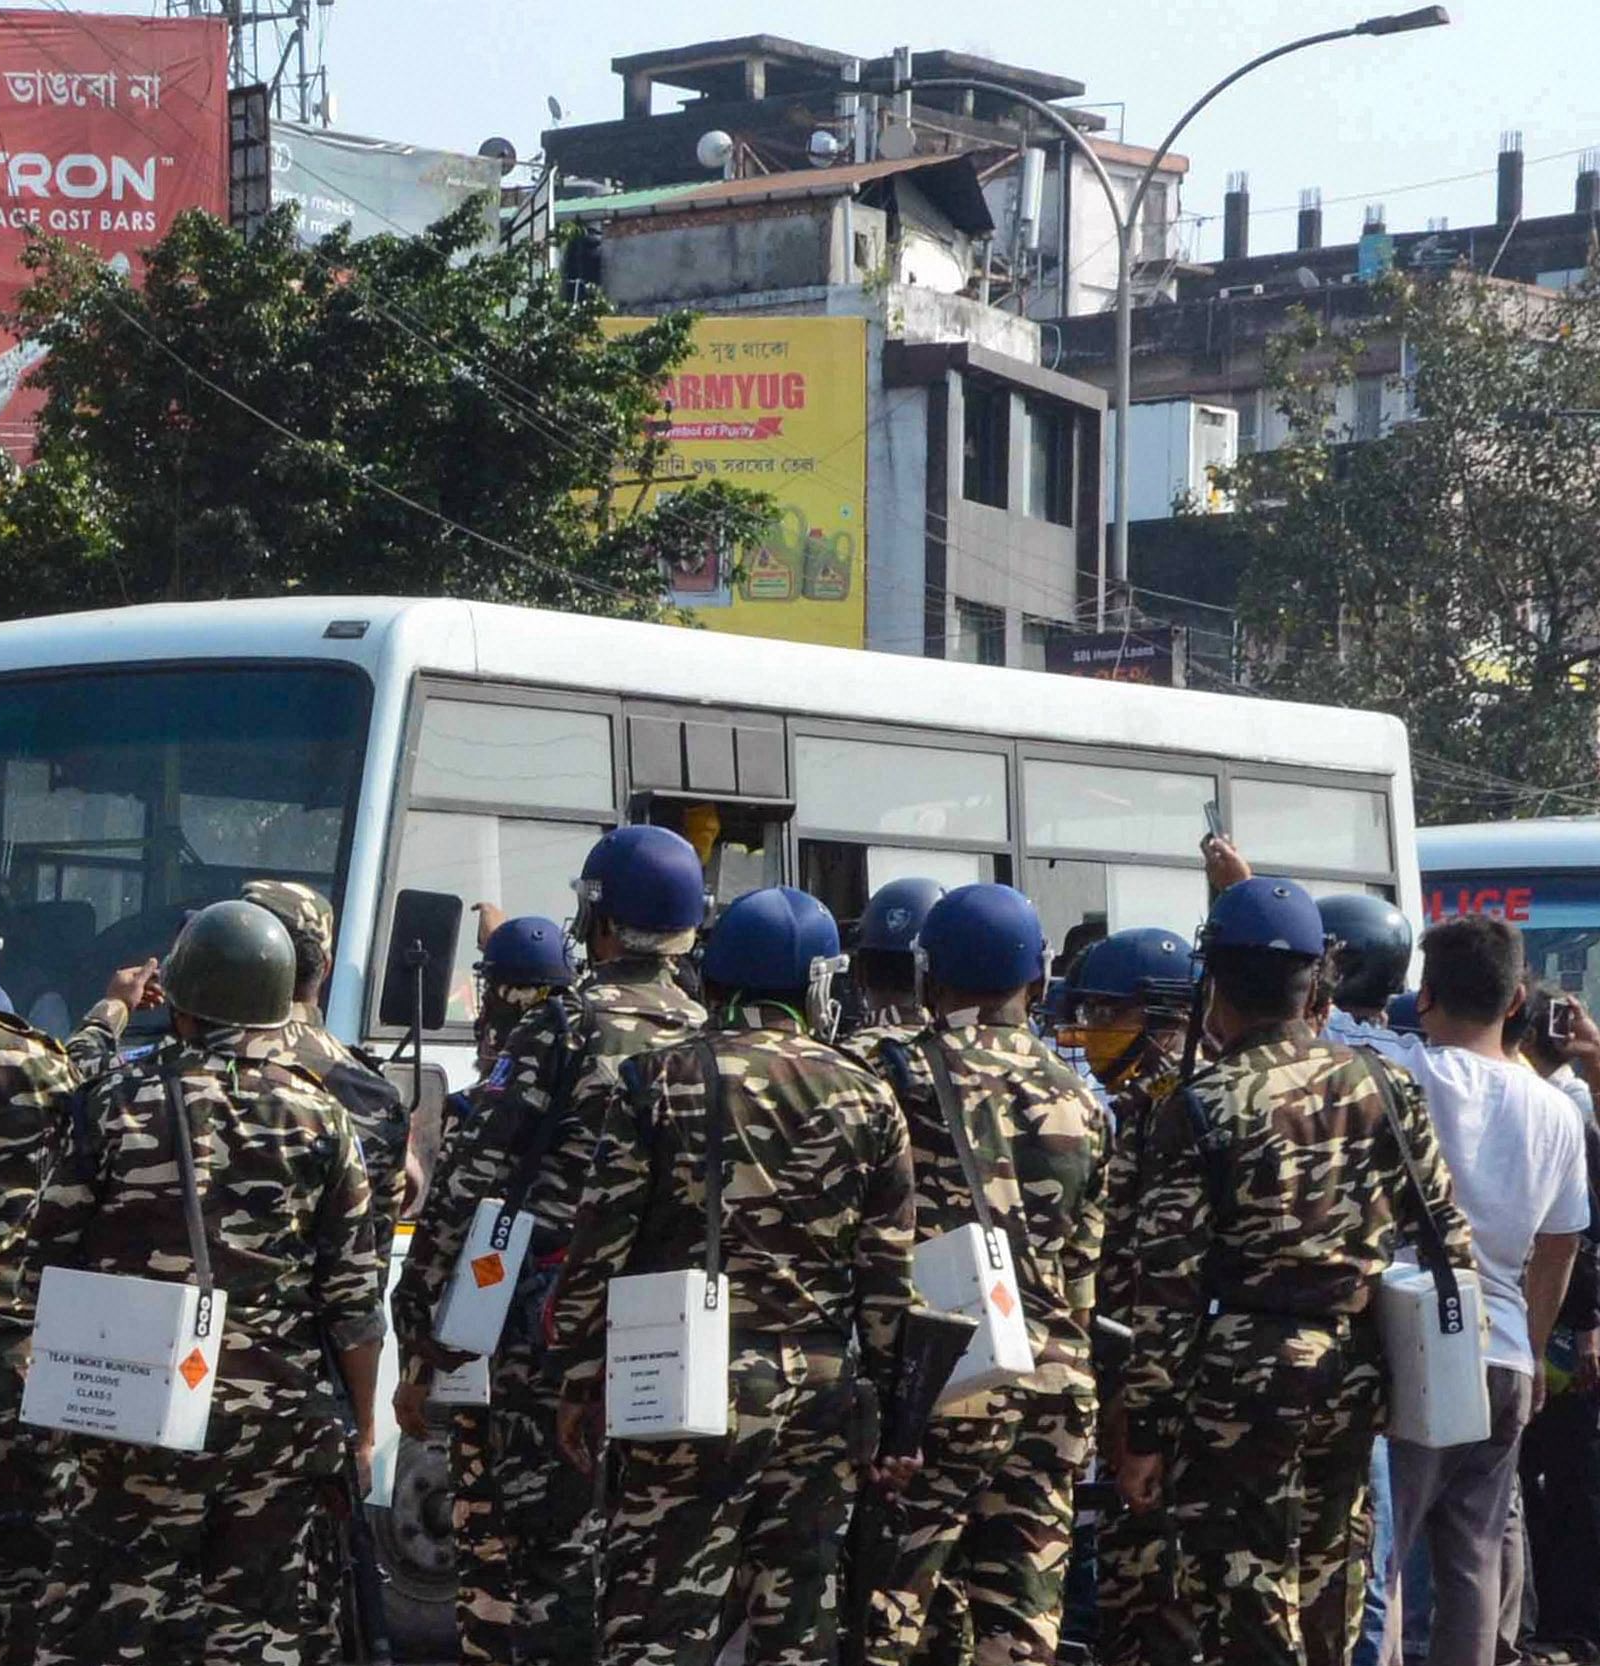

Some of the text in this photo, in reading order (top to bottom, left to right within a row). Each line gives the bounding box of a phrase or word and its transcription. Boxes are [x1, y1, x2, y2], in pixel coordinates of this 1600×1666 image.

[127, 75, 161, 109] না
[50, 211, 91, 232] QST
[100, 214, 156, 232] BARS
